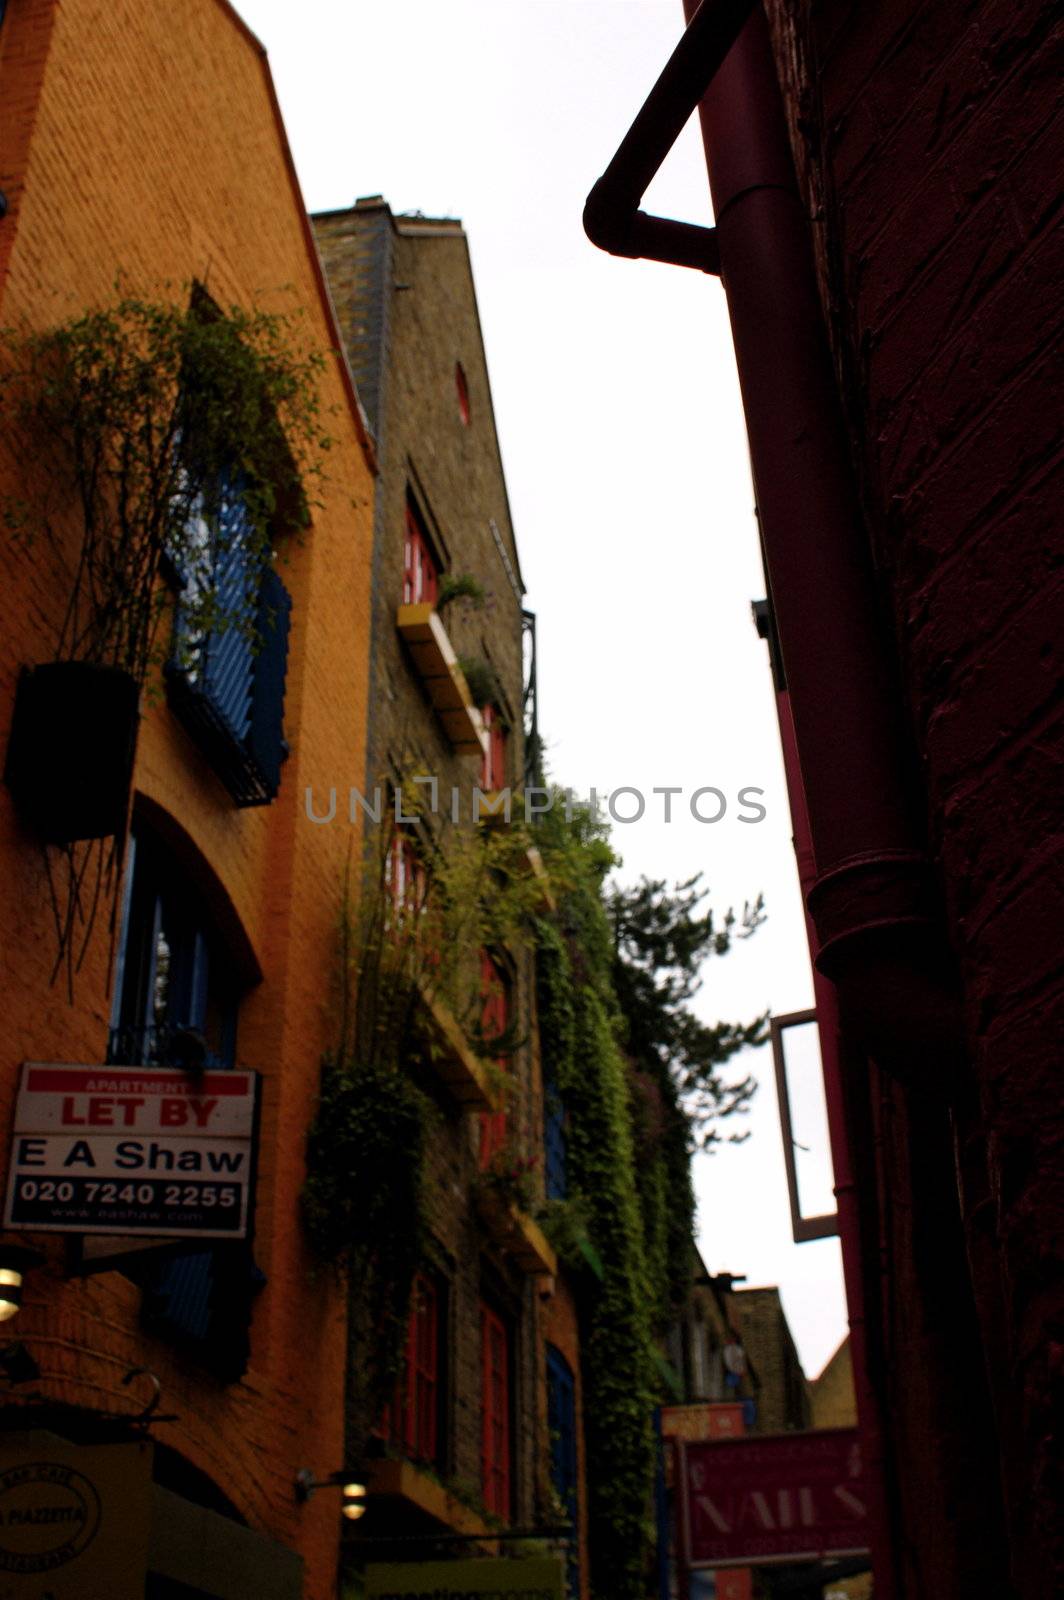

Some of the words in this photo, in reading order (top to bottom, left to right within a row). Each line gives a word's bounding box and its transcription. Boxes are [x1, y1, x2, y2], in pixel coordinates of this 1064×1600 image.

[62, 1097, 145, 1126] LET
[160, 1099, 219, 1127] BY
[18, 1139, 47, 1166] E
[64, 1141, 97, 1167] A
[115, 1142, 244, 1173] Shaw
[20, 1181, 74, 1202] 020
[84, 1183, 155, 1205] 7240
[164, 1186, 236, 1208] 2255
[695, 1485, 867, 1534] NAILS
